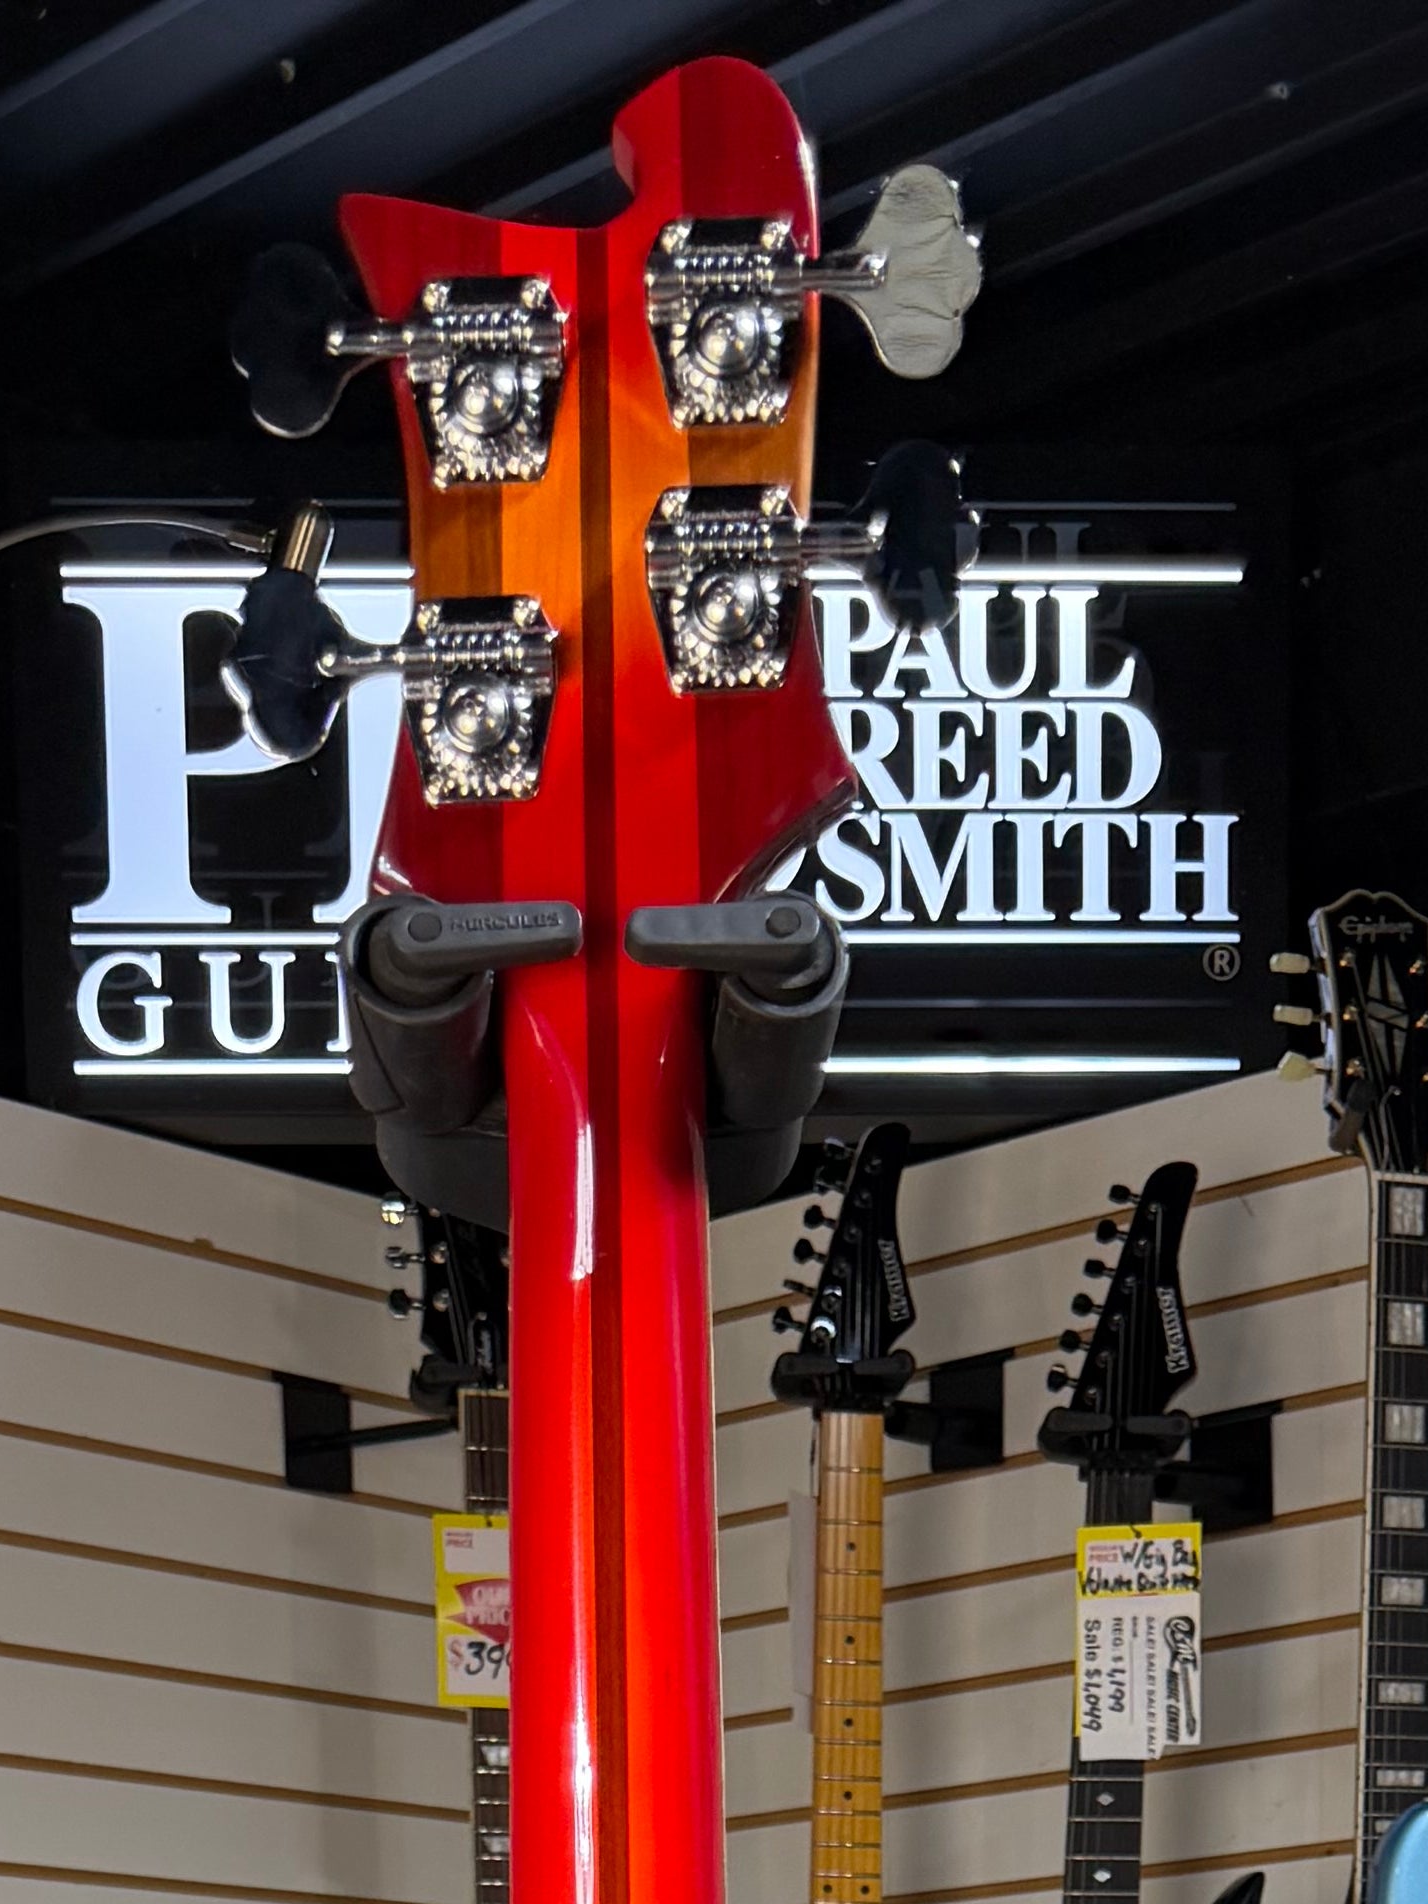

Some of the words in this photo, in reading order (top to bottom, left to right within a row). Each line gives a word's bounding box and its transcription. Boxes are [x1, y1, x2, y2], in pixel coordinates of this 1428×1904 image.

[813, 586, 1136, 699] PAUL
[828, 702, 1163, 811] REED
[814, 809, 1241, 923] SMITH
[1337, 914, 1414, 943] Epiphone
[1166, 1703, 1180, 1744] CENTER
